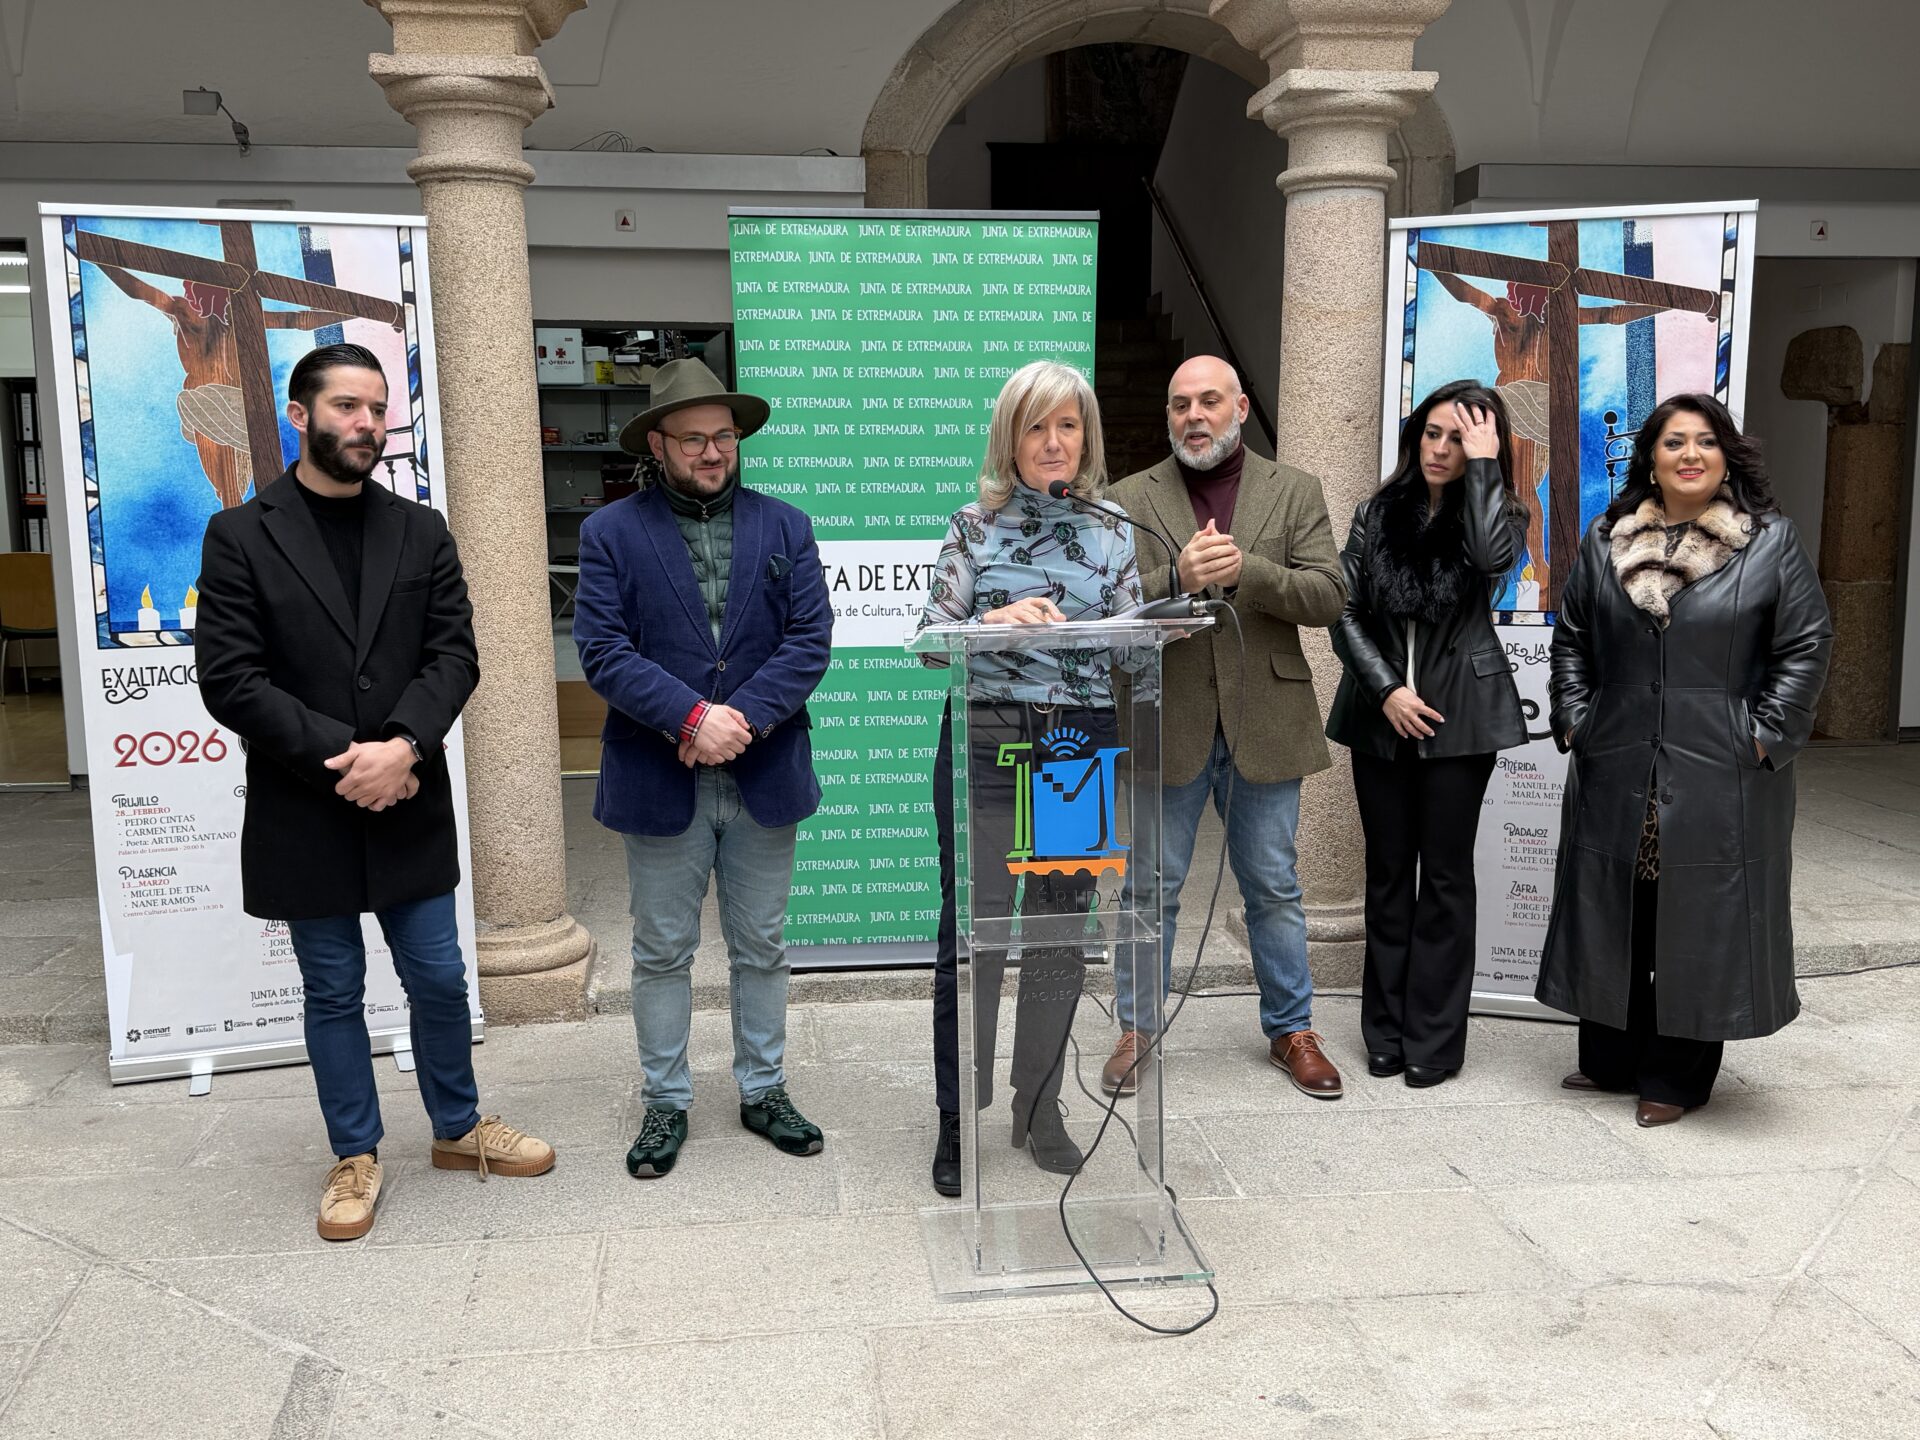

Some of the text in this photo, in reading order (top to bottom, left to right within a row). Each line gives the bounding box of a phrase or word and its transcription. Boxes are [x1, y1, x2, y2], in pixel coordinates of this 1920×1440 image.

[735, 224, 1092, 238] JUNTA DE EXTREMADURA JUNTA DE EXTREMADURA JUNTA DE EXTREMADURA
[735, 251, 1093, 266] EXTREMADURA JUNTA DE EXTREMADURA JUNTA DE EXTREMADURA JUNTA DE
[737, 282, 1091, 296] JUNTA DE EXTREMADURA JUNTA DE EXTREMADURA JUNTA DE EXTREMADURA
[737, 309, 1093, 323] EXTREMADURA JUNTA DE EXTREMADURA JUNTA DE EXTREMADURA JUNTA DE
[739, 340, 1091, 352] JUNTA DE EXTREMADURA JUNTA DE EXTREMADURA JUNTA DE EXTREMADURA
[740, 367, 974, 379] EXTREMADURA JUNTA DE EXTREMADURA JUNTA DE
[772, 398, 973, 410] DE EXTREMADURA JUNTA DE EXTREMADURA
[814, 424, 975, 436] JUNTA DE EXTREMADURA JUNTA DE
[744, 457, 973, 469] JUNTA DE EXTREMADURA JUNTA DE EXTREMADURA
[815, 483, 975, 495] JUNTA DE EXTREMADURA JUNTA DE
[865, 516, 906, 527] JUNTA DE
[858, 564, 886, 591] DE
[845, 604, 859, 617] de
[849, 659, 859, 669] DE
[867, 691, 908, 702] JUNTA DE
[820, 715, 928, 728] JUNTA DE EXTREMADURA
[113, 728, 228, 767] 2026
[869, 748, 908, 760] JUNTA DE
[820, 773, 928, 787] JUNTA DE EXTREMADURA
[1512, 781, 1550, 790] MANUEL
[112, 794, 159, 808] TRUJILLO
[1512, 790, 1541, 801] MARÍA
[869, 803, 909, 815] JUNTA DE
[124, 814, 196, 827] PEDRO CINTAS
[125, 825, 196, 838] CARMEN TENA
[821, 828, 929, 841] JUNTA DE EXTREMADURA
[1504, 822, 1548, 838] BADAJOZ
[126, 831, 237, 848] Poeta: ARTURO SANTANO
[1510, 845, 1521, 854] EL
[797, 858, 909, 871] EXTREMADURA JUNTA DE
[1510, 855, 1539, 865] MAITE
[118, 865, 177, 880] PLASENCIA
[130, 884, 211, 899] MIGUEL DE TENA
[822, 882, 929, 896] JUNTA DE EXTREMADURA
[1510, 880, 1538, 897] ZAFRA
[131, 895, 196, 910] NANE RAMOS
[1512, 902, 1541, 912] JORGE
[798, 911, 910, 924] EXTREMADURA JUNTA DE
[1512, 911, 1541, 921] ROCÍO
[1491, 946, 1527, 958] JUNTA DE
[250, 988, 290, 1002] JUNTA DE
[143, 1026, 171, 1036] cemart
